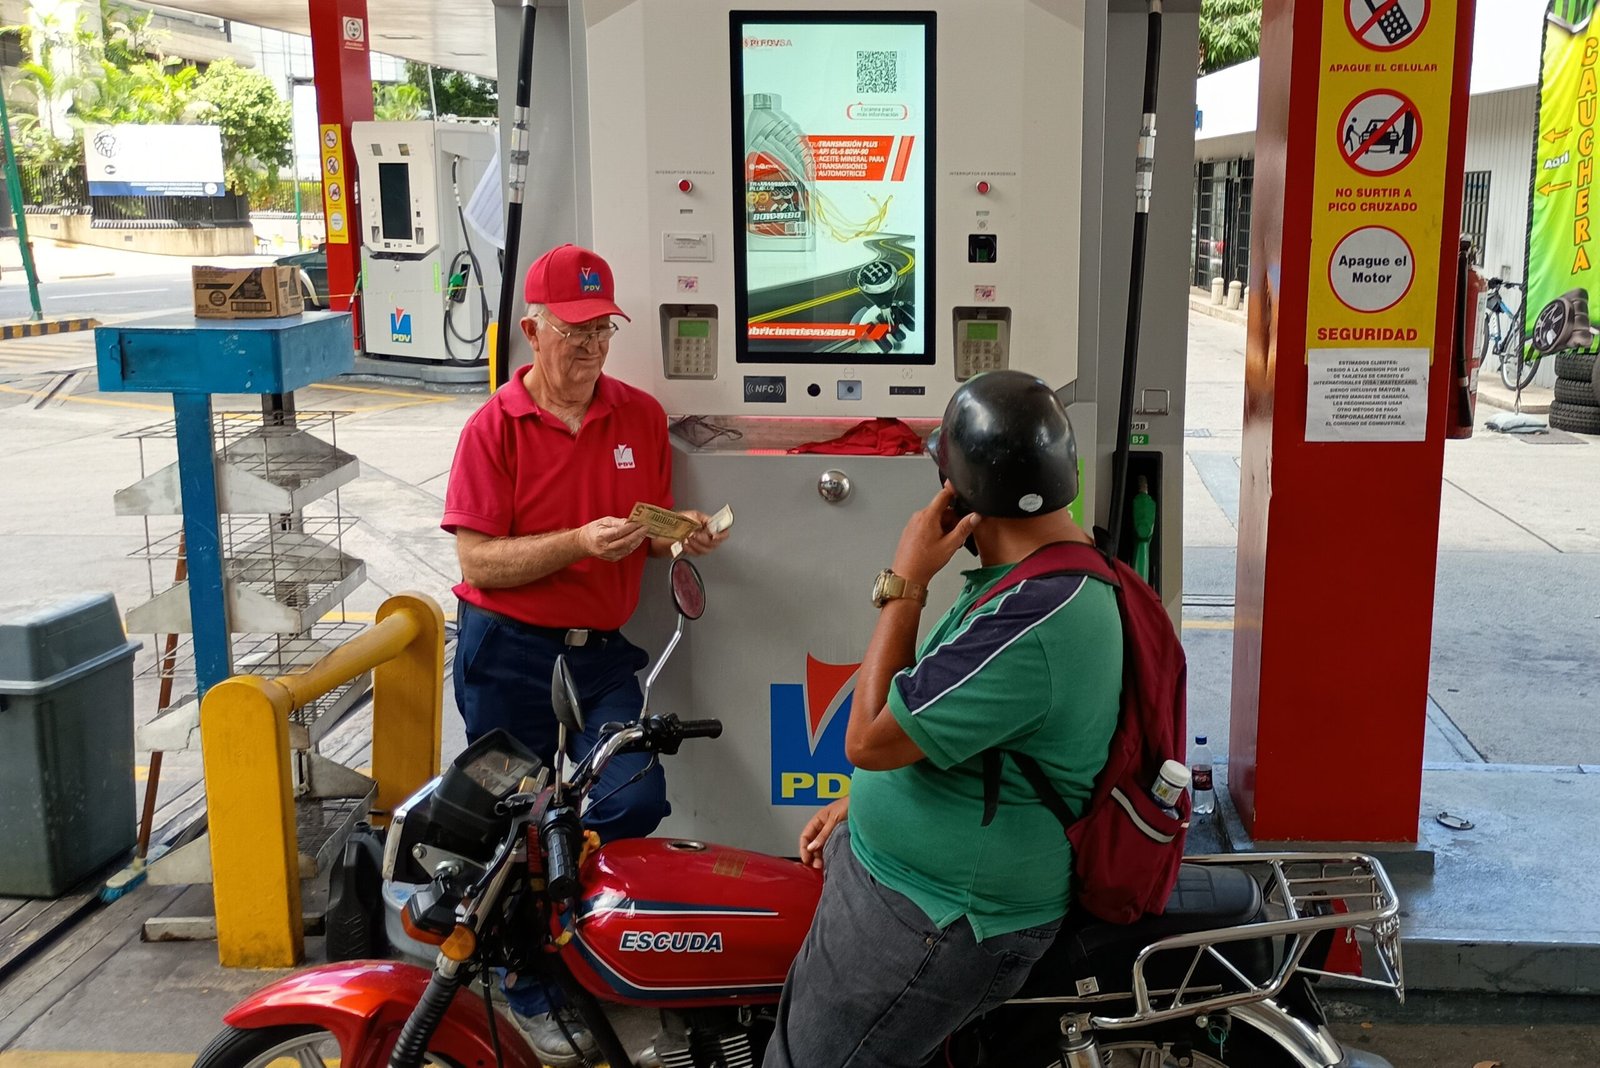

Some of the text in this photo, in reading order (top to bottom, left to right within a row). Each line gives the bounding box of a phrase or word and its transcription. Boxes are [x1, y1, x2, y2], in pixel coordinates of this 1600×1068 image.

[1329, 63, 1438, 73] APAGUE EL CELULAR
[1571, 36, 1599, 275] CAUCHERA
[1335, 188, 1412, 198] NO SURTIR A
[1328, 202, 1418, 212] PICO CRUZADO
[1339, 255, 1407, 269] Apague el
[1352, 272, 1392, 283] Motor
[392, 333, 411, 342] PDV
[1317, 328, 1418, 341] SEGURIDAD
[755, 384, 775, 393] NFC
[1132, 435, 1144, 444] B2
[781, 771, 854, 799] PD
[619, 930, 723, 953] ESCUDA
